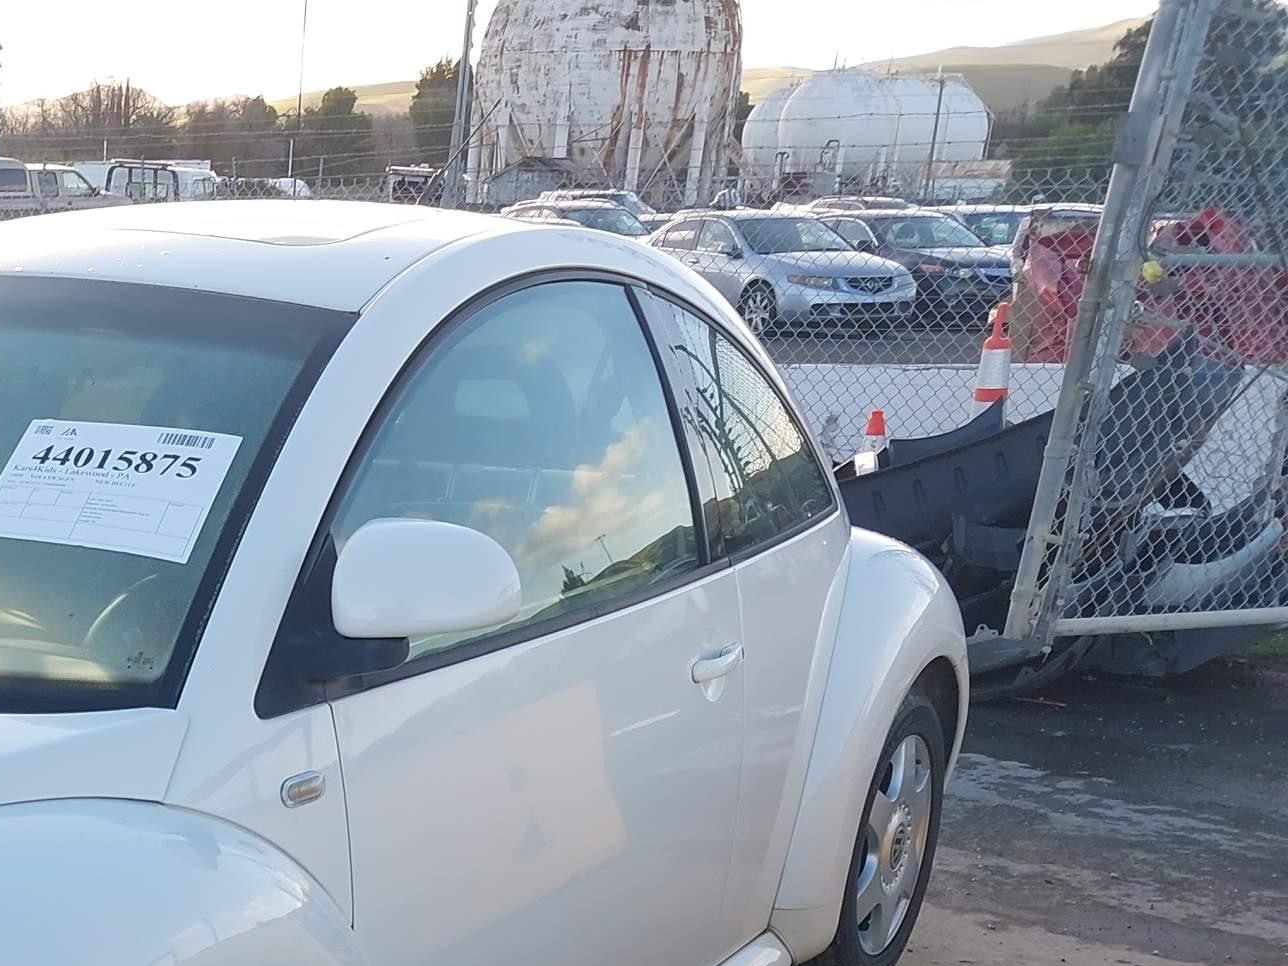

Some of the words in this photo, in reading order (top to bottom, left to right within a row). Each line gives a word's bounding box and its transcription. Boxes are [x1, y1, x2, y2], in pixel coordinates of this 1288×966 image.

[12, 464, 57, 474] Kars4Kids
[64, 467, 110, 478] Lakewood
[31, 444, 202, 479] 44015875
